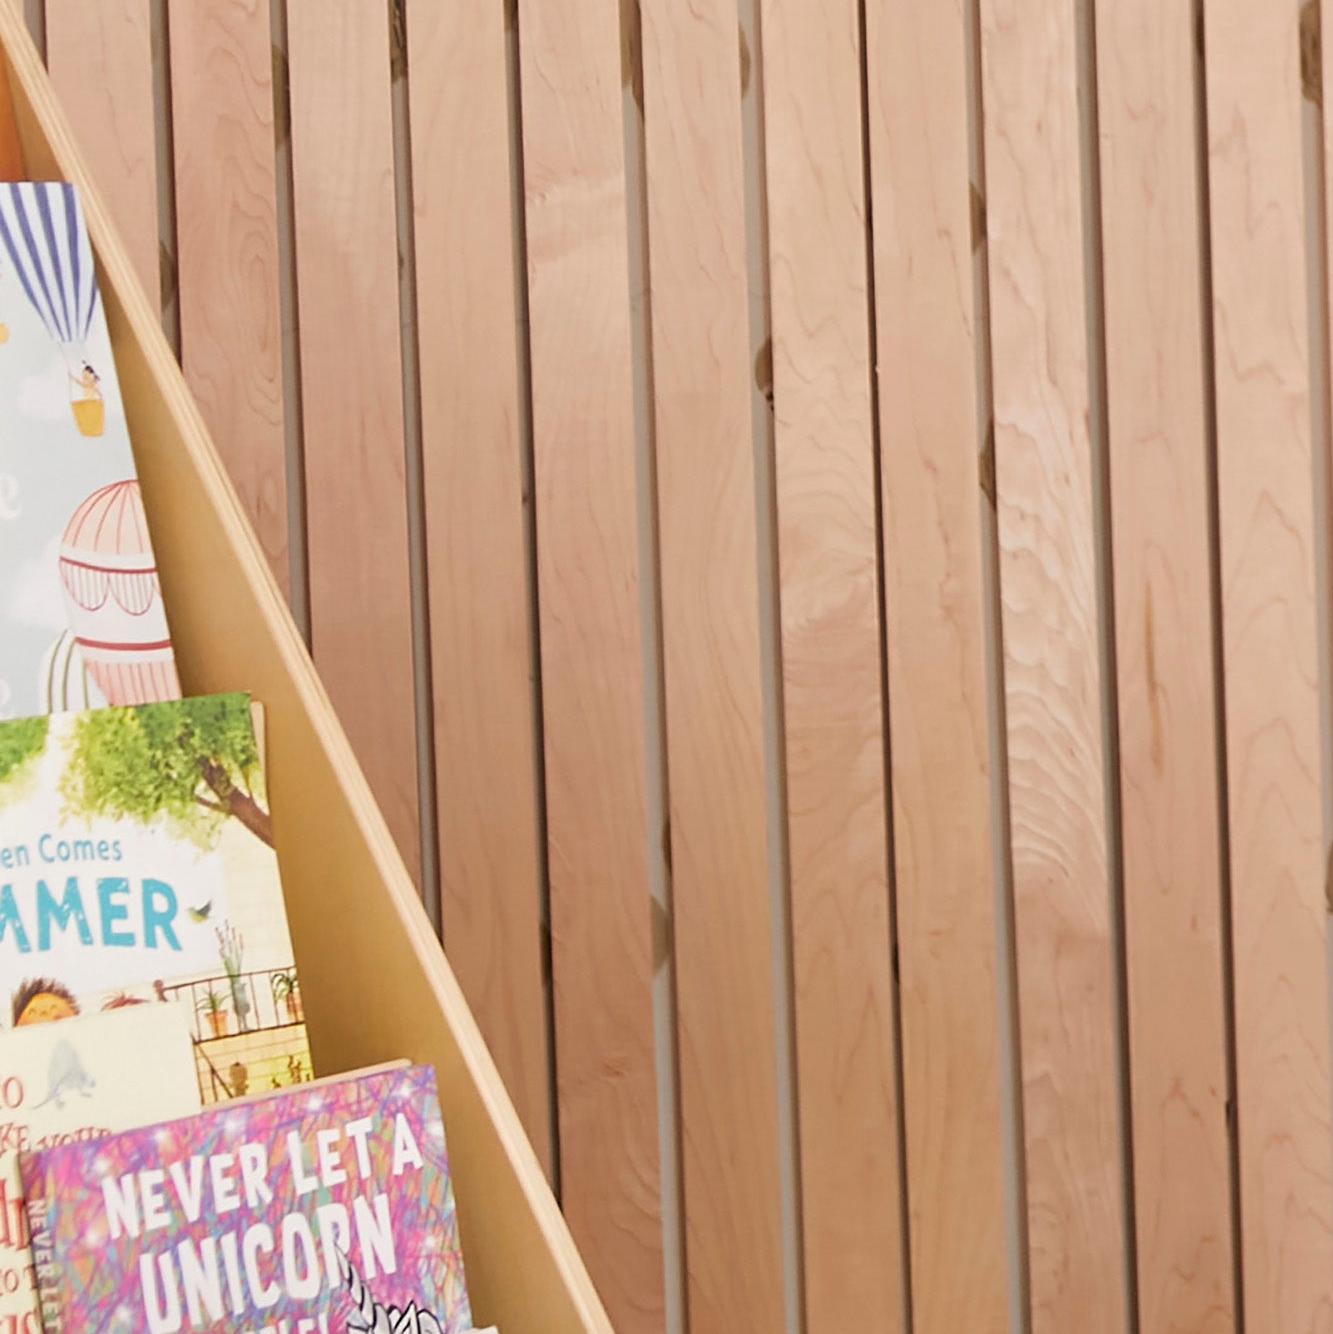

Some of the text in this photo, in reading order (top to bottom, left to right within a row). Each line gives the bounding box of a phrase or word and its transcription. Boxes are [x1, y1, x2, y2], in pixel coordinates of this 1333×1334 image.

[39, 834, 122, 863] Comes
[101, 1142, 273, 1240] NEVER
[287, 1116, 374, 1196] LET
[392, 1112, 424, 1175] A
